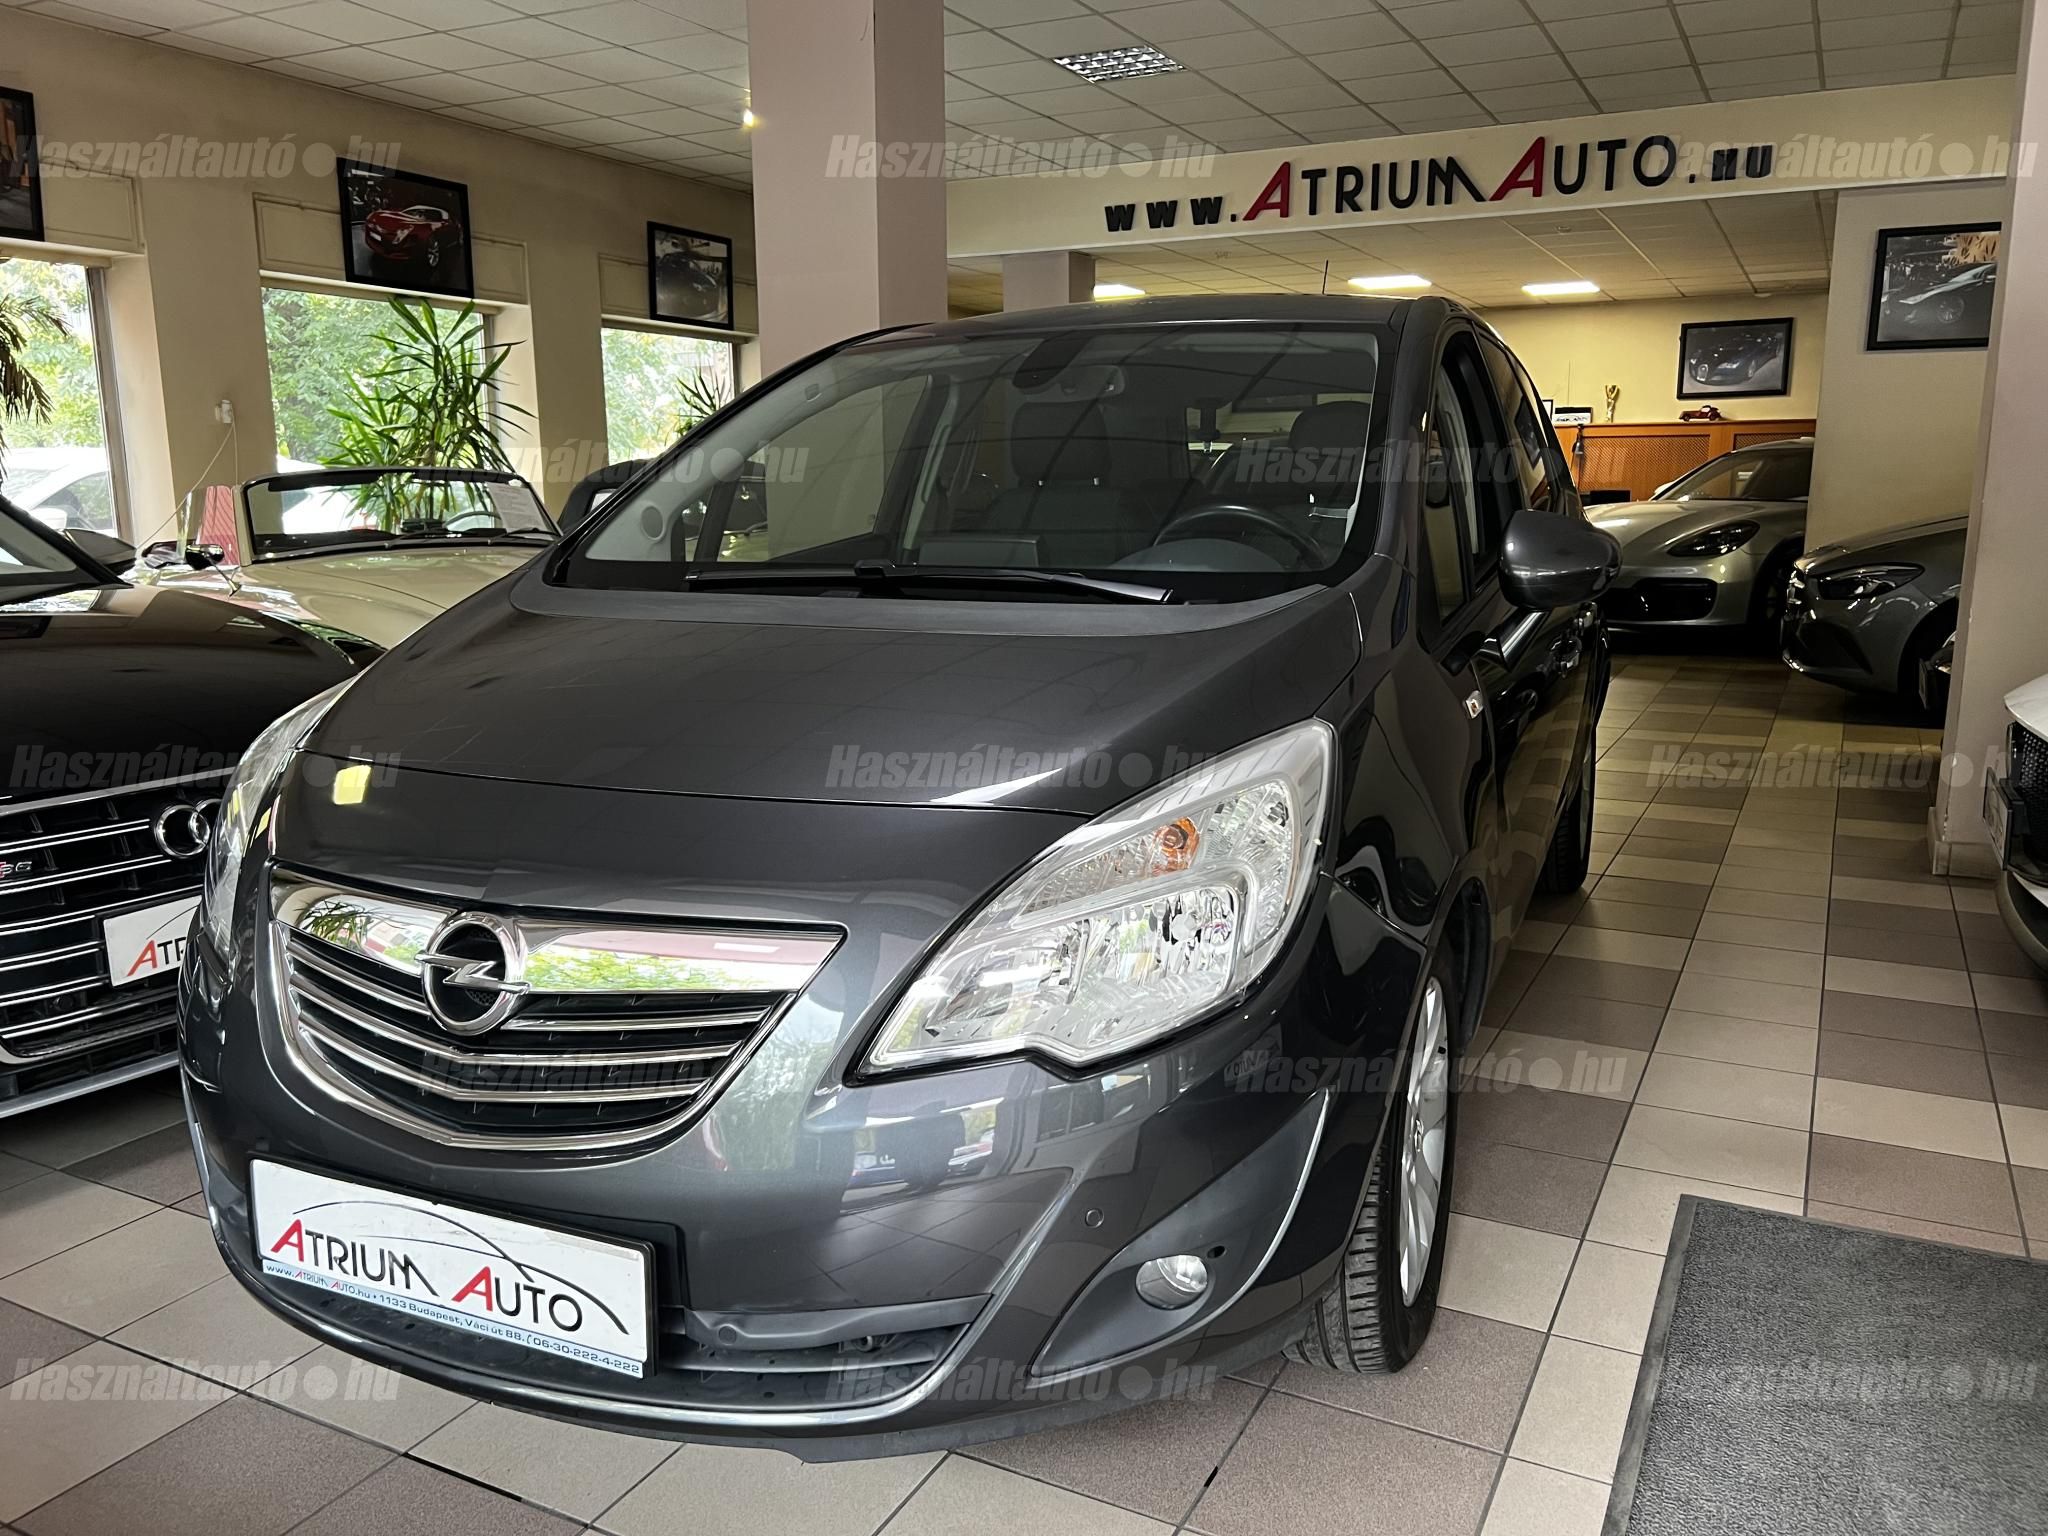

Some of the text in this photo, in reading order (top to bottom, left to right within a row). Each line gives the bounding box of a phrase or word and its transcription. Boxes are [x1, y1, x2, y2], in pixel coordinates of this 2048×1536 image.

[270, 1218, 583, 1333] ATRIUM AUTO
[379, 1294, 407, 1309] 1133
[409, 1302, 463, 1327] Budapest,
